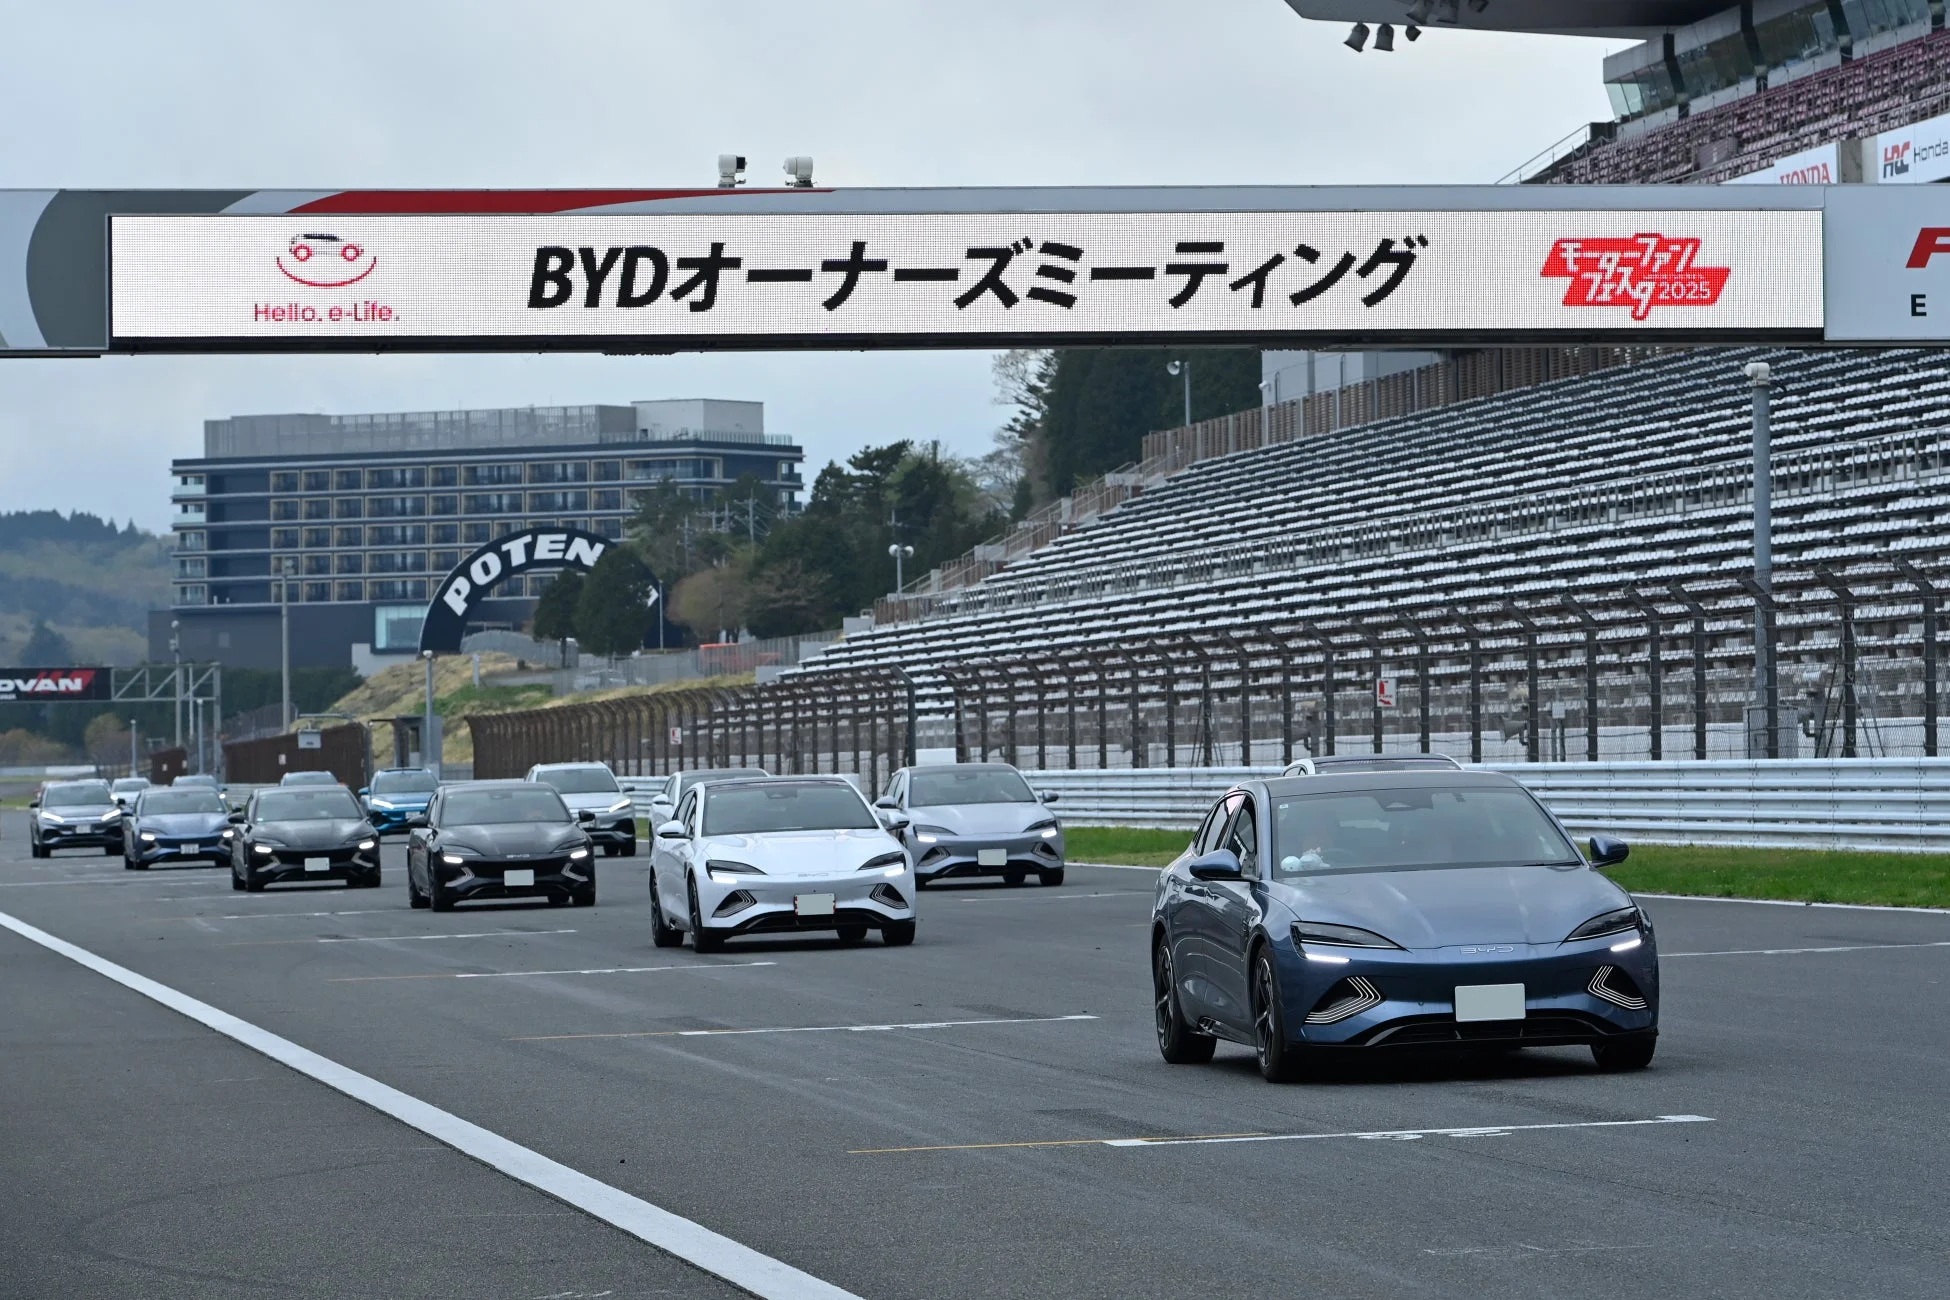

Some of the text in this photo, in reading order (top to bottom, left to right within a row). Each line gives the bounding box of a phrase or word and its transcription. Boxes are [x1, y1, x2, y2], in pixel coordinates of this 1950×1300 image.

[1914, 137, 1949, 163] Honda
[527, 234, 1429, 313] BYDオーナーズミーティング
[1658, 281, 1711, 300] 2025
[254, 300, 400, 322] Hello. e-Life.
[443, 533, 659, 617] POTEN
[0, 677, 83, 693] DVAN
